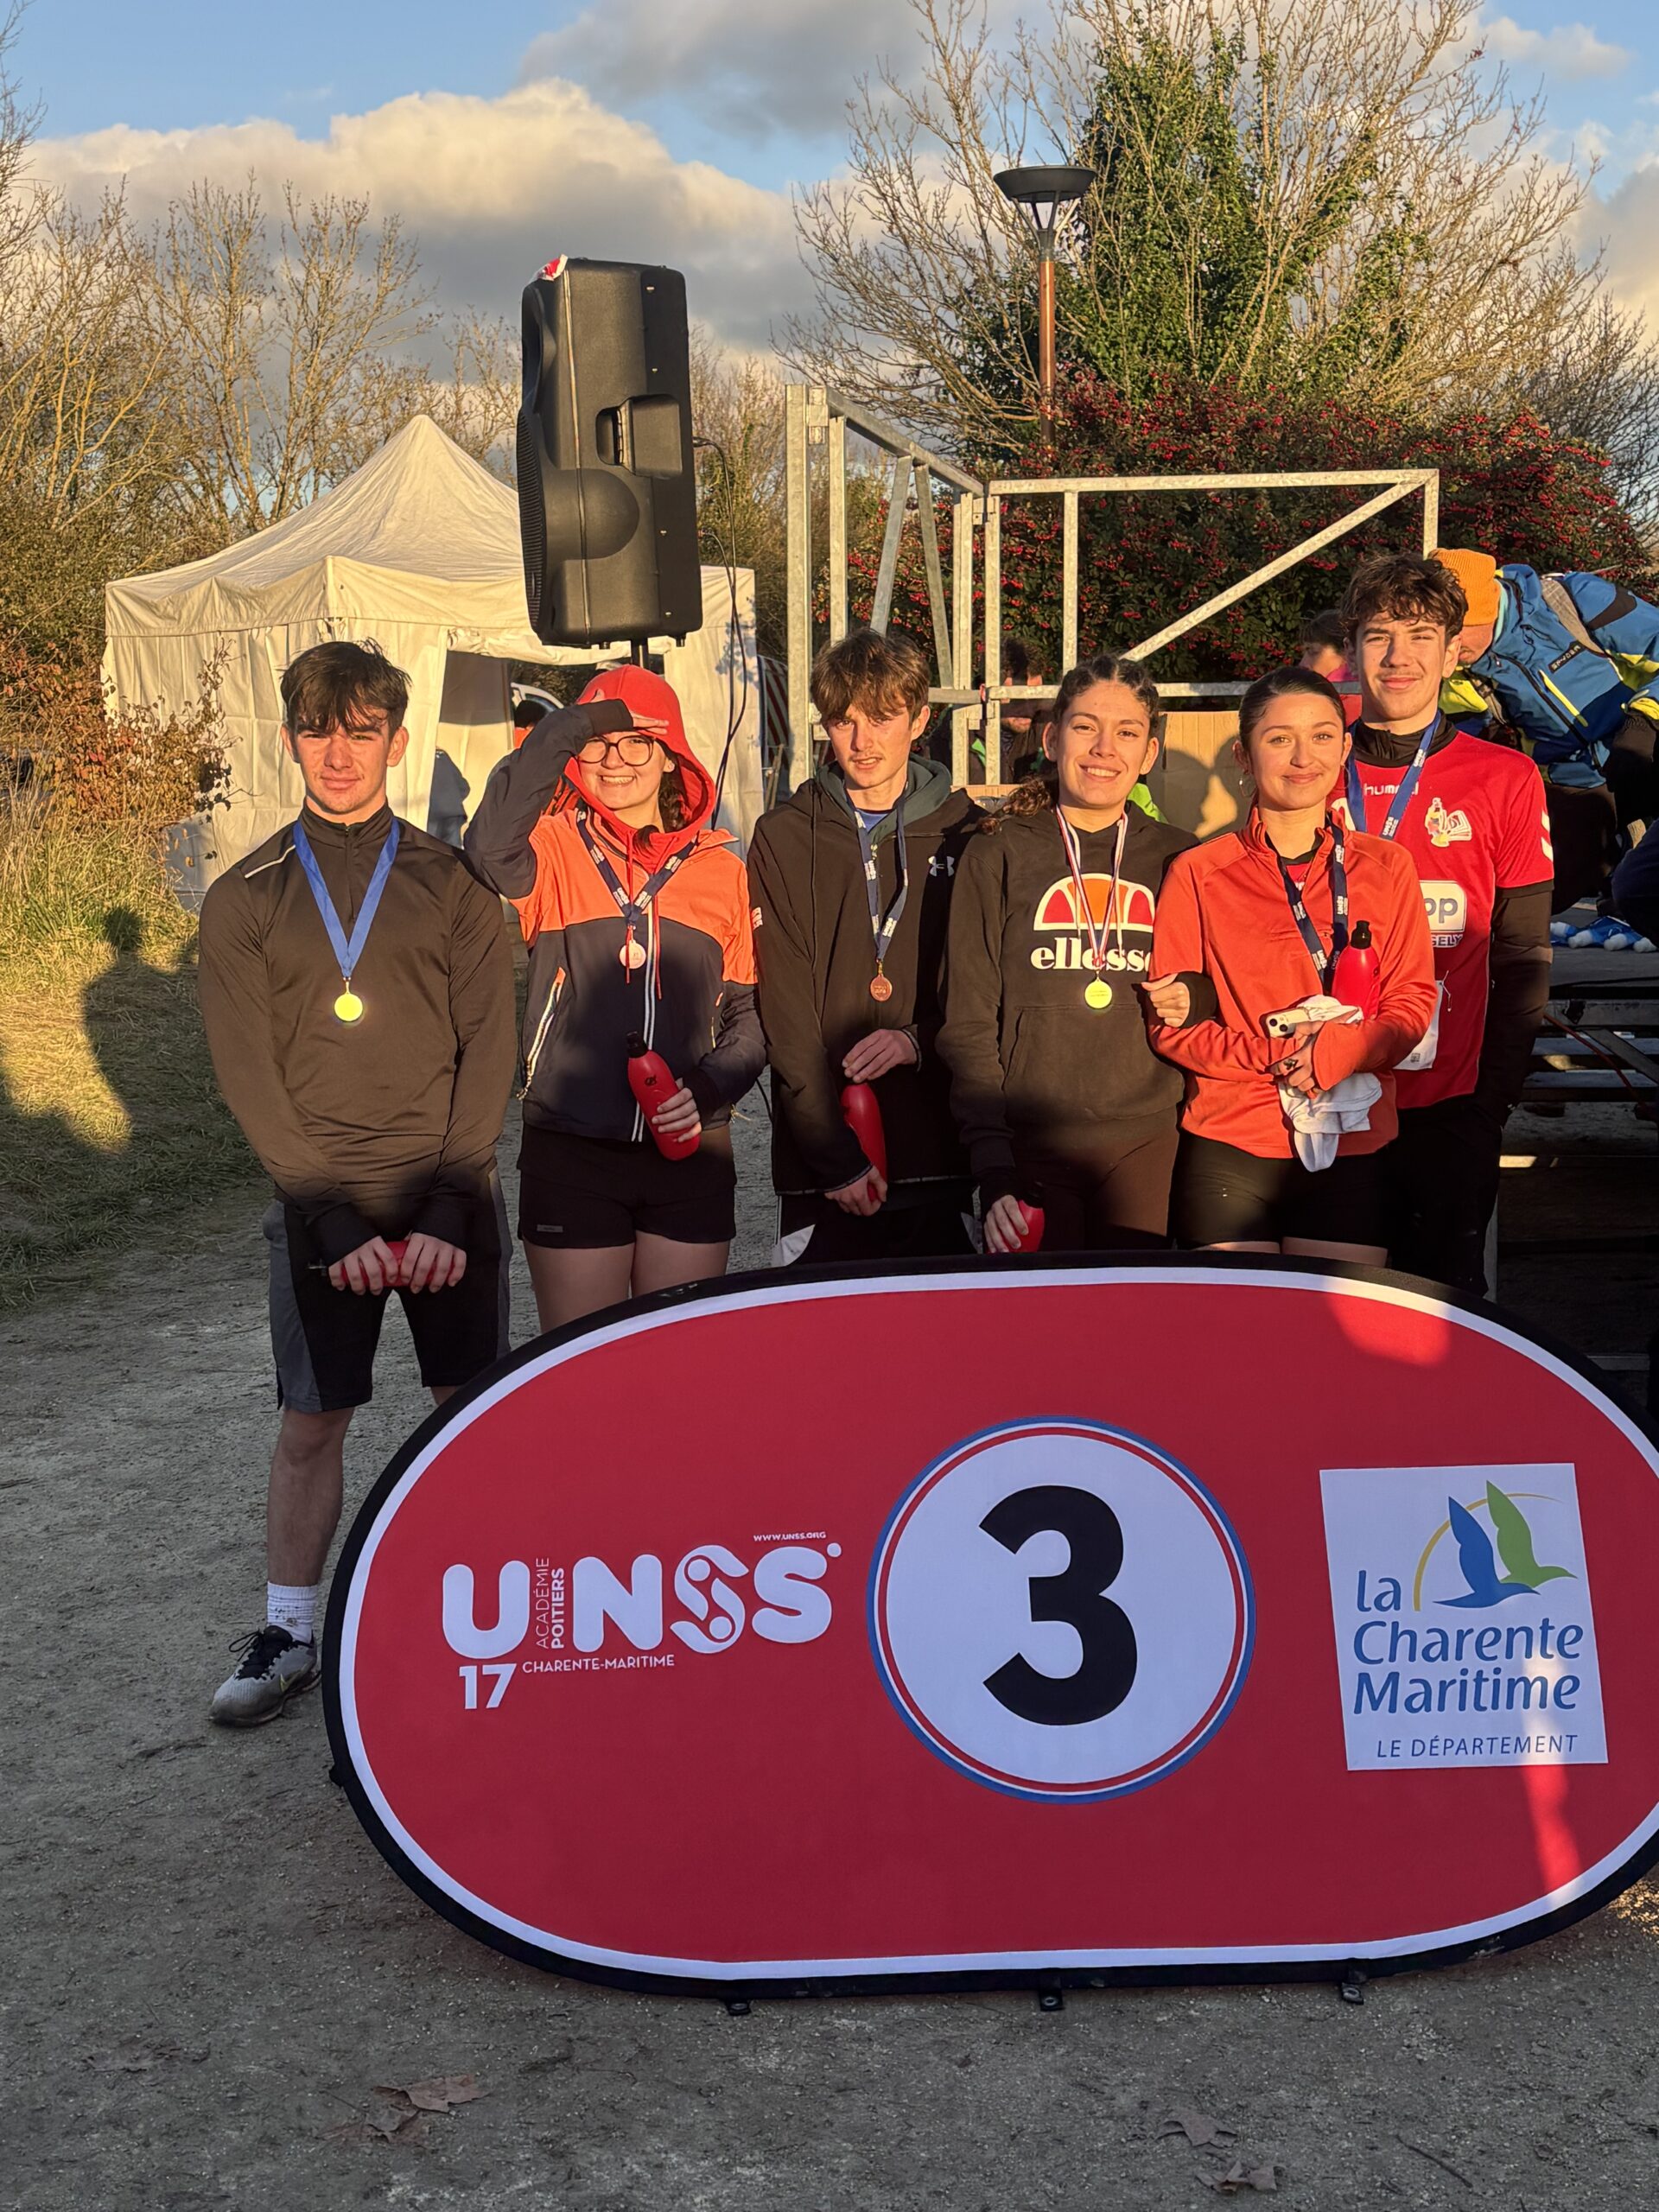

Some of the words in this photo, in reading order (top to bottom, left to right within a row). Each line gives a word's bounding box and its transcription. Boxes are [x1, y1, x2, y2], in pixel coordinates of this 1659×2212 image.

[1030, 937, 1153, 972] elless
[753, 1531, 827, 1541] WWW.UNSS.ORG
[442, 1544, 833, 1658] UNSS
[533, 1557, 550, 1649] ACADÉMIE
[551, 1567, 564, 1649] POITIERS
[979, 1485, 1137, 1726] 3
[1356, 1570, 1402, 1612] la
[522, 1654, 675, 1674] CHARENTE-MARITIME
[1353, 1618, 1583, 1665] Charente
[459, 1662, 517, 1709] 17
[1353, 1667, 1580, 1714] Maritime
[1377, 1740, 1402, 1758] LE
[1411, 1734, 1578, 1758] DÉPARTEMENT
